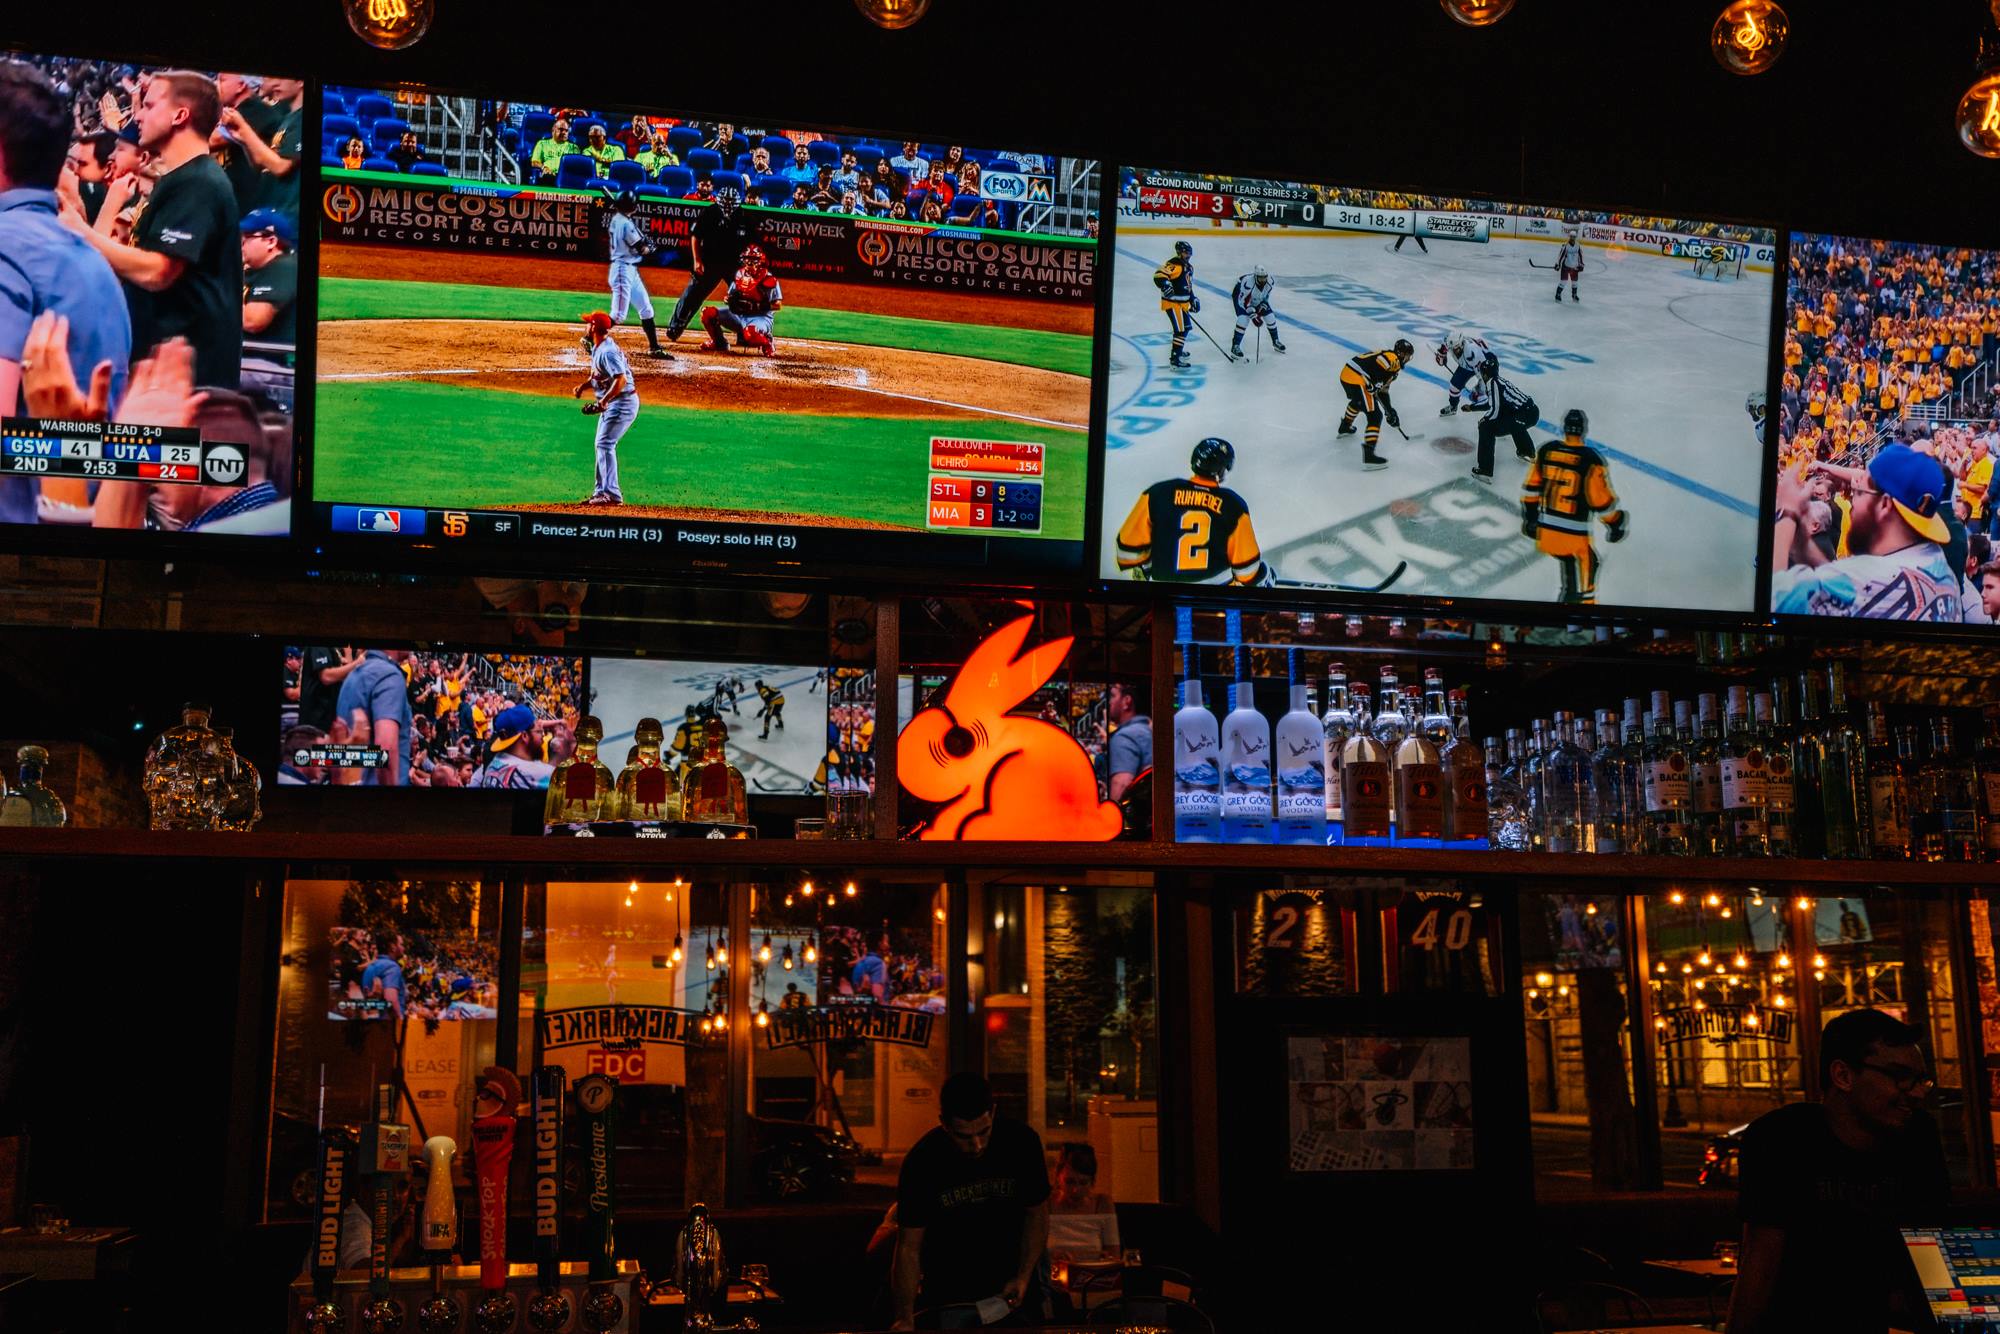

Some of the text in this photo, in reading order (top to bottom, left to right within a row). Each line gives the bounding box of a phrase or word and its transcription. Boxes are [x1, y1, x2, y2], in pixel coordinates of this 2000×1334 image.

[992, 177, 1017, 190] FOX
[1146, 176, 1308, 200] SECOND ROUND PIT LEADS SERIES 3-2
[369, 188, 589, 223] MICCOSUKEE
[535, 192, 592, 204] MARLINS.COM
[1169, 193, 1199, 210] WSH
[1211, 195, 1224, 213] 3
[1265, 203, 1287, 218] PIT
[1302, 204, 1315, 222] 0
[370, 210, 589, 239] RESORT & GAMING
[803, 222, 846, 239] WEEK
[1339, 211, 1405, 228] 3rd 18:42
[1427, 216, 1461, 227] STANLEY
[342, 227, 578, 251] MICCOSUKEE.COM
[1624, 232, 1680, 245] HONDA
[897, 236, 1094, 271] MICCOSUKEE
[1681, 245, 1736, 263] NBCSN
[896, 254, 1093, 286] RESORT & GAMING
[873, 269, 1082, 297] MICCOSUKEE.COM
[39, 420, 162, 438] WARRIORS LEAD 3-0
[11, 439, 191, 462] GSW 41 UTA 25
[1026, 446, 1039, 454] 14
[14, 457, 179, 479] 2ND 9:53 24
[205, 458, 244, 474] TNT
[936, 458, 1039, 472] ICHIRO .154
[933, 483, 1006, 497] STL 9 8
[932, 507, 1017, 522] MIA 3 1-2
[495, 522, 511, 533] SF
[532, 524, 797, 549] Pence: 2-run HR (3) Posey: solo HR (3)
[1177, 510, 1212, 571] 2
[1295, 797, 1323, 808] GOOSE
[1411, 908, 1473, 951] 40
[406, 1058, 457, 1074] LEASE
[588, 1054, 644, 1077] FDC
[535, 1094, 558, 1237] BUD LIGHT
[589, 1120, 610, 1214] Presidente
[318, 1145, 346, 1268] BUD LIGHT
[481, 1175, 497, 1260] SHOCK TOP
